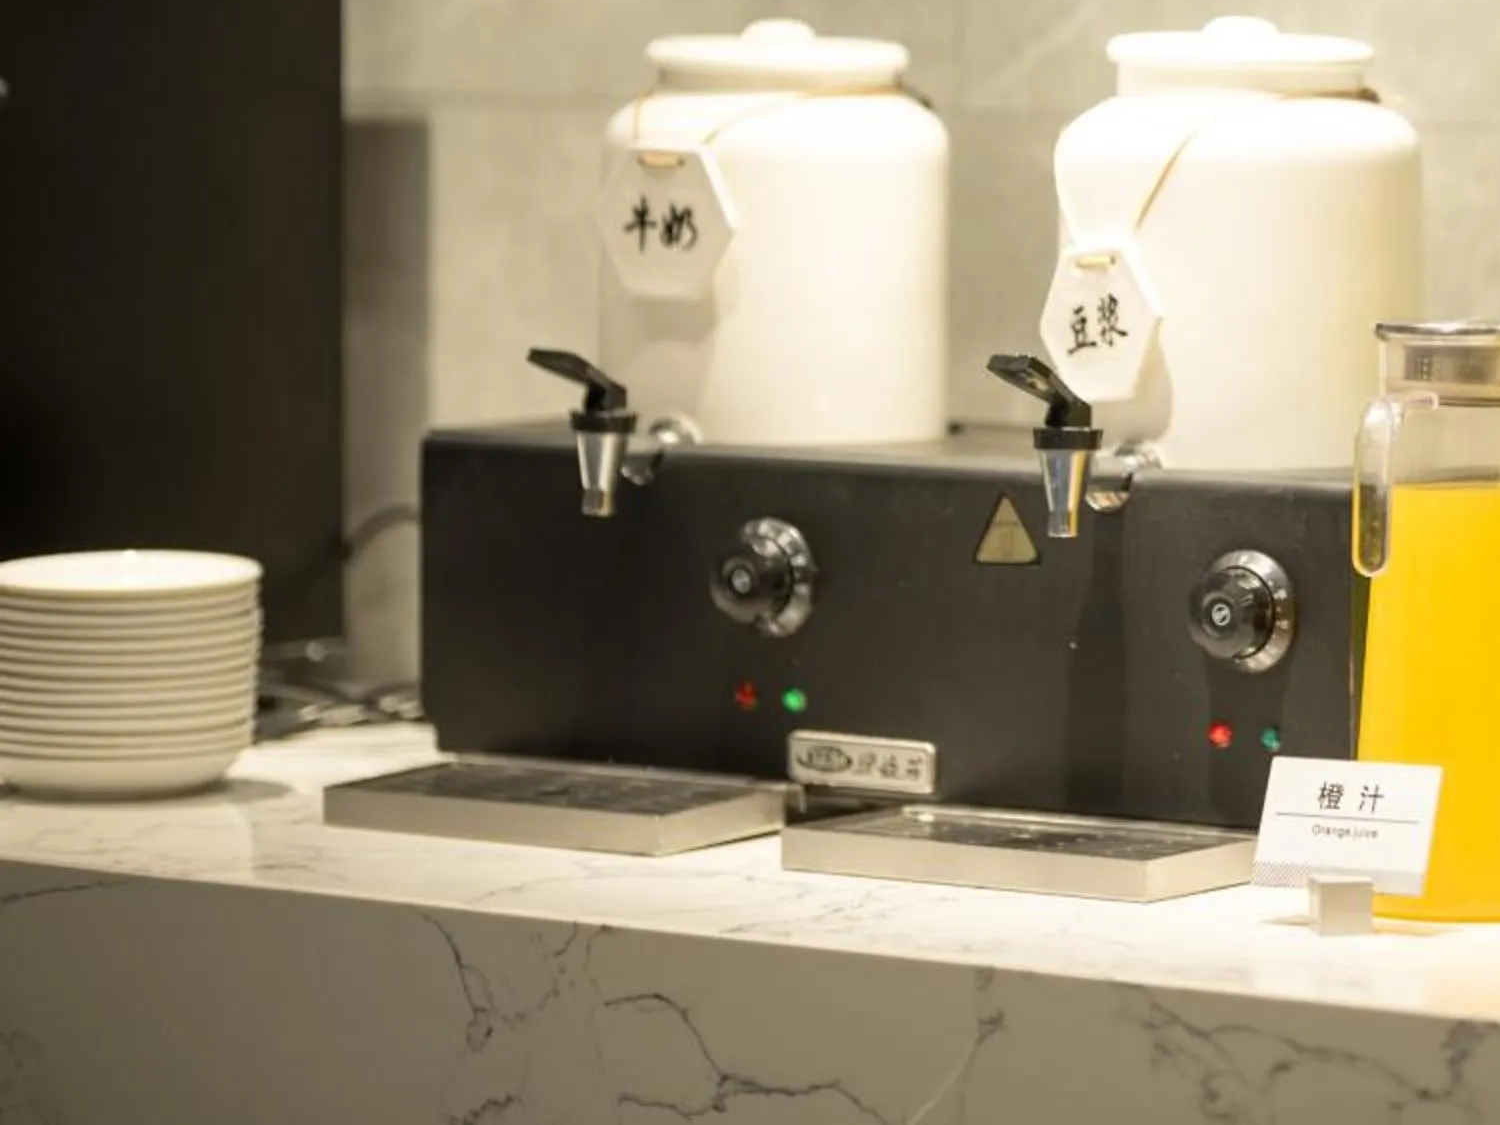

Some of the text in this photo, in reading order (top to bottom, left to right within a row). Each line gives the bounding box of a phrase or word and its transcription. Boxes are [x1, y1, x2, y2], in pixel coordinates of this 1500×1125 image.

[623, 194, 698, 252] 牛奶
[1067, 293, 1128, 355] 豆浆
[1317, 781, 1385, 814] 橙汁
